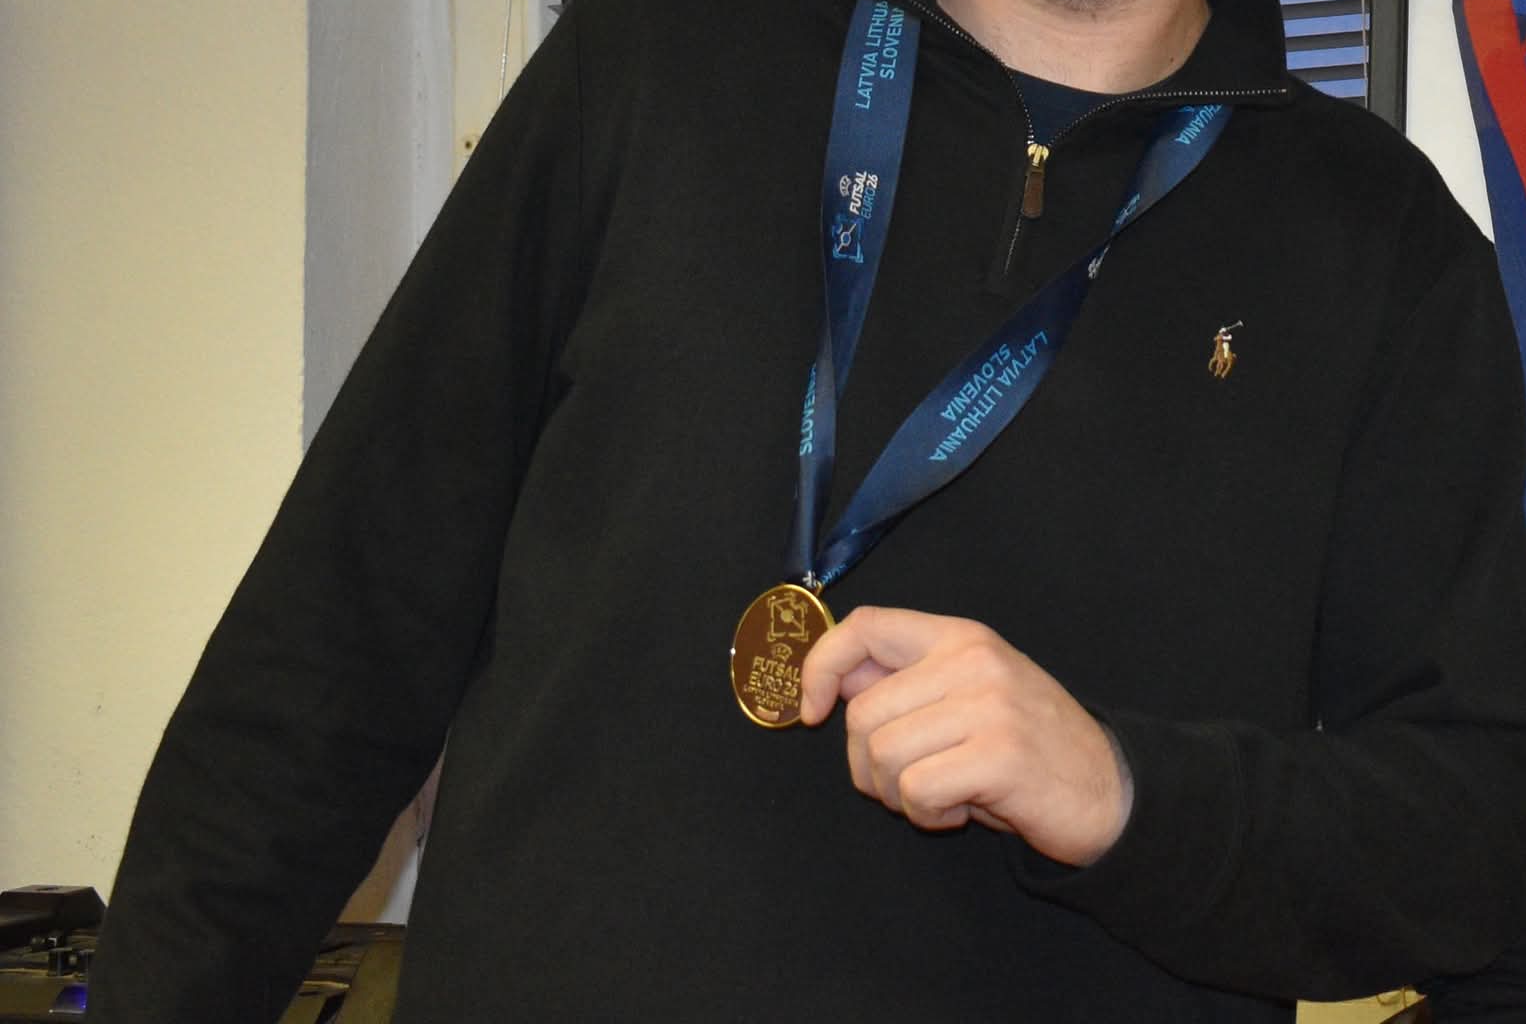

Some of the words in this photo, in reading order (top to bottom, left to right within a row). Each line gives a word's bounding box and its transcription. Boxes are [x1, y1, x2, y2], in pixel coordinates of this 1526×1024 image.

[855, 52, 879, 110] LATVIA
[849, 171, 867, 216] FUTSAL
[940, 343, 1011, 421] SLOVENIA
[997, 331, 1048, 387] LATVIA
[928, 385, 1003, 461] LITHUANIA
[752, 656, 801, 683] FUTSAL
